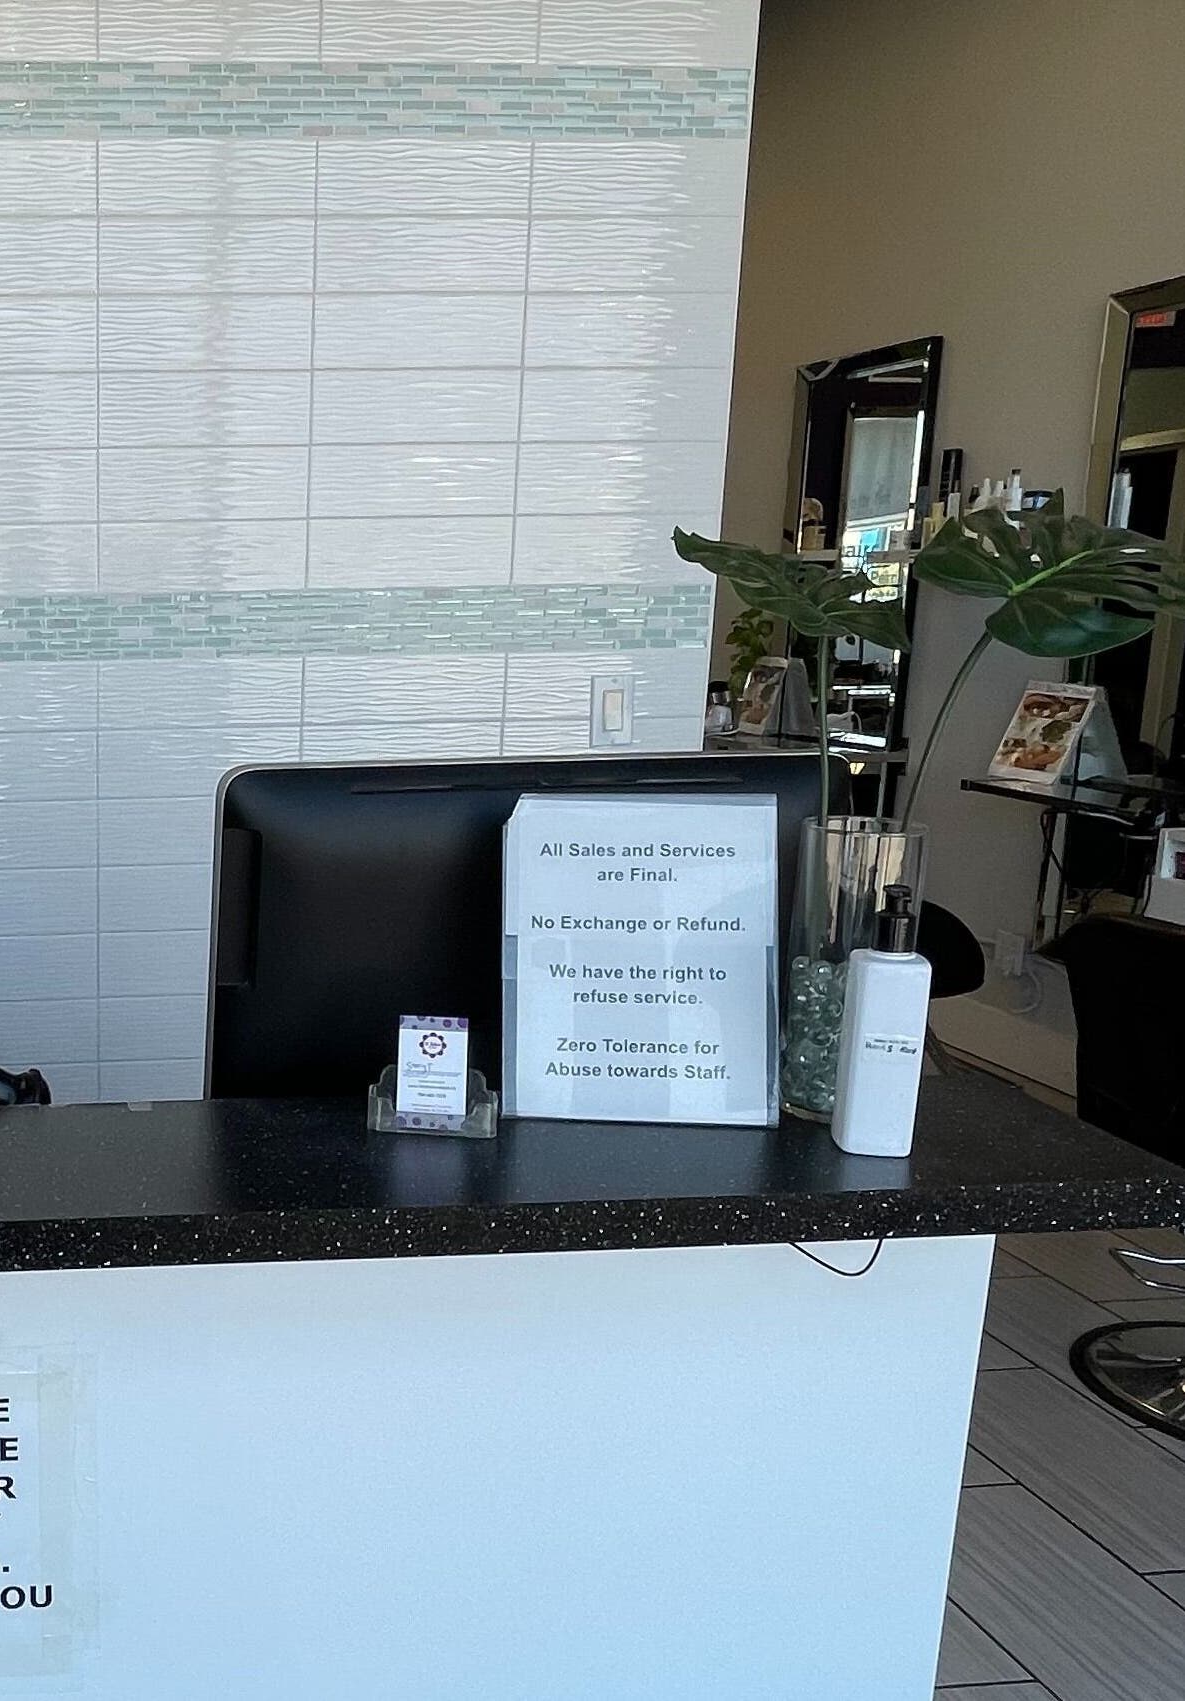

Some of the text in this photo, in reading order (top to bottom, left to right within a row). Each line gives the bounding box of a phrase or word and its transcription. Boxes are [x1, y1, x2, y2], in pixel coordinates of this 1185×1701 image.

[539, 842, 736, 858] All Sales and Services
[597, 867, 677, 882] are Final.
[531, 915, 746, 934] No Exchange or Refund.
[549, 963, 727, 984] We have the right to
[573, 988, 703, 1005] refuse service.
[556, 1037, 720, 1055] Zero Tolerance for
[545, 1062, 731, 1080] Abuse towards Staff.
